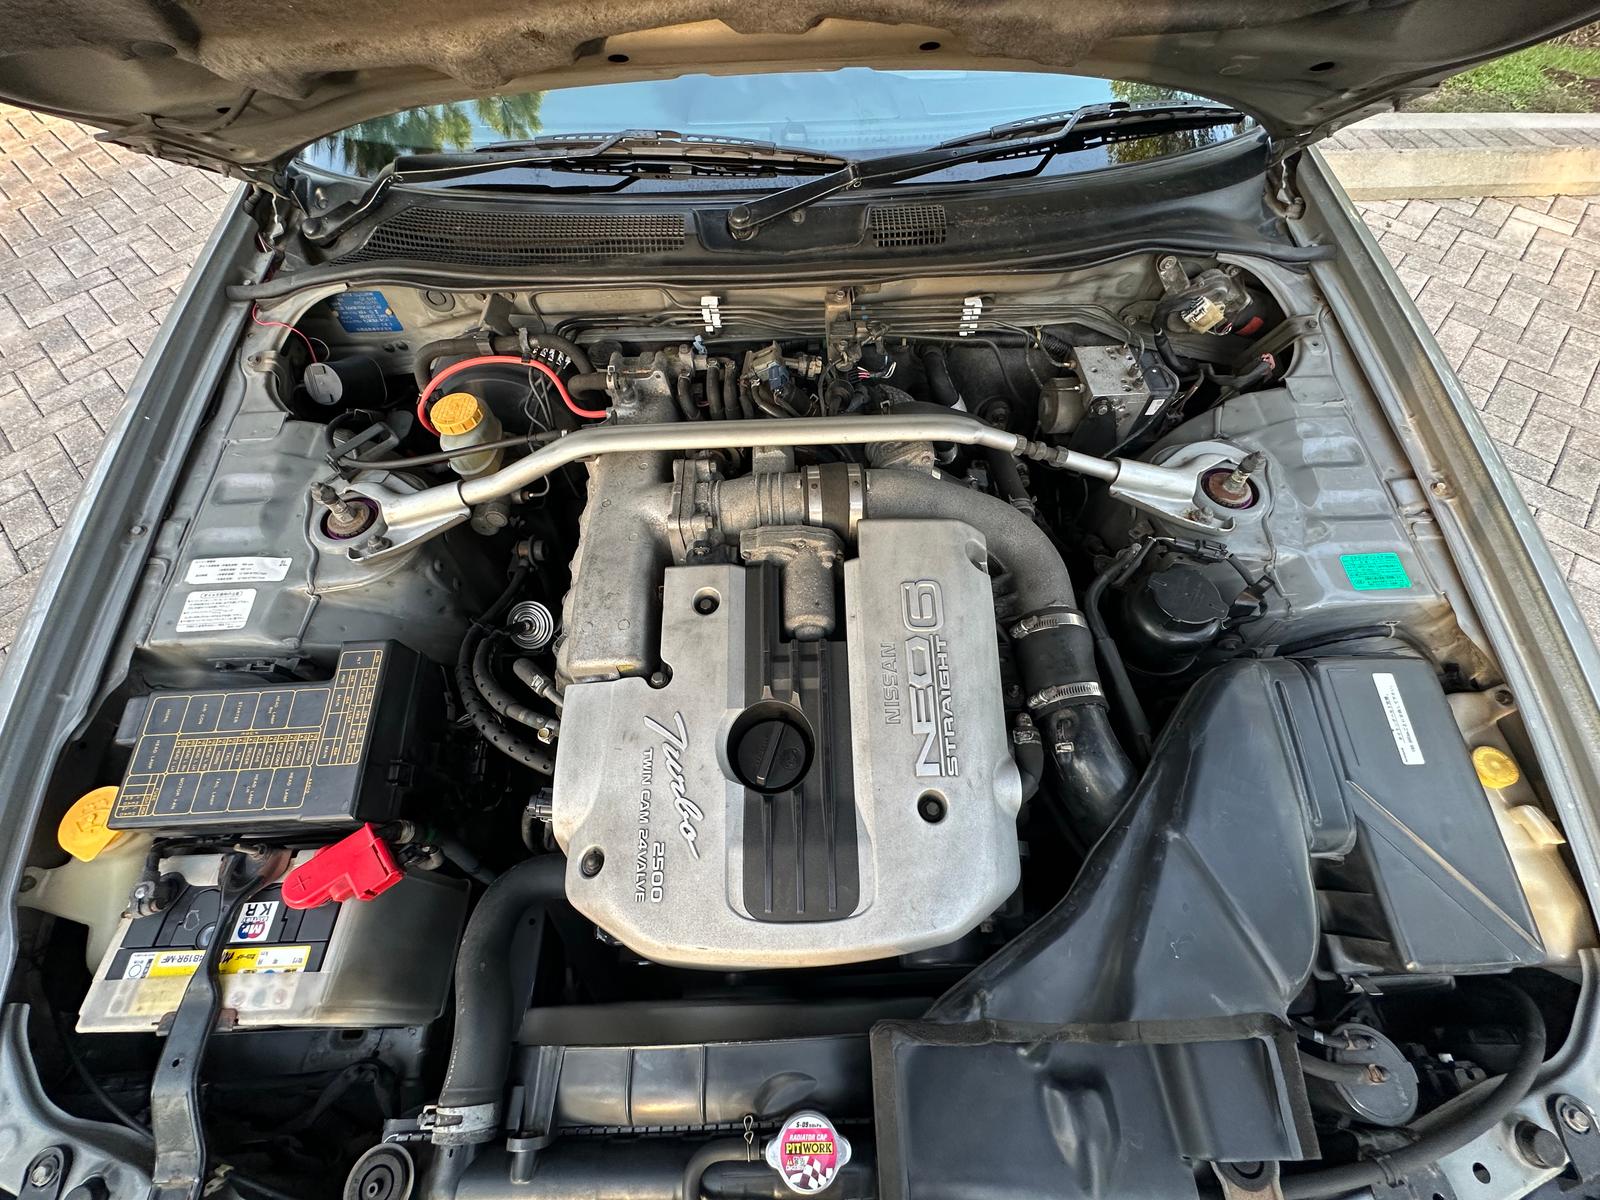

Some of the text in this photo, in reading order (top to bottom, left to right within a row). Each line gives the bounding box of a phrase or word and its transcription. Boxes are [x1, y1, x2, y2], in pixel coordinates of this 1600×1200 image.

[232, 701, 242, 723] STARTER
[880, 641, 901, 725] NISSAN
[935, 635, 959, 777] STRAIGHT
[641, 747, 654, 785] TWIN
[643, 711, 704, 860] Turbo
[639, 789, 652, 824] CAM
[651, 841, 665, 904] 2500
